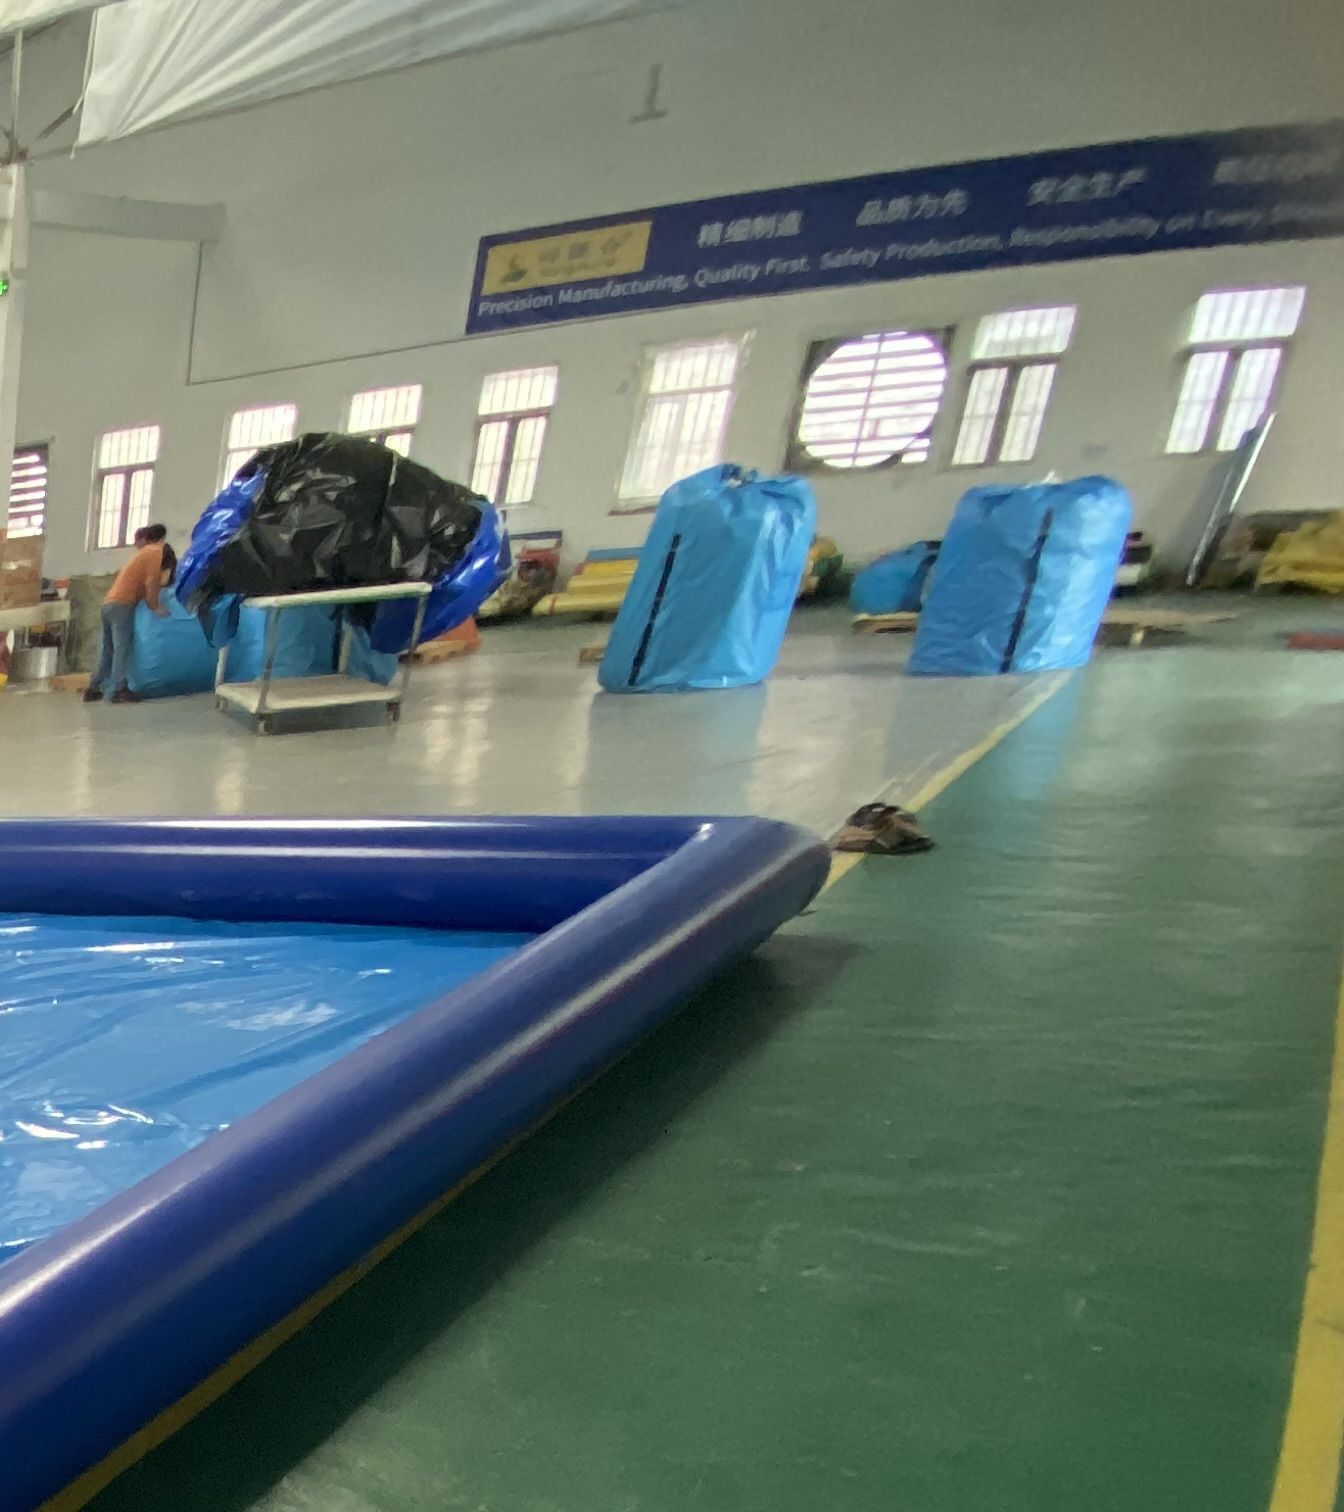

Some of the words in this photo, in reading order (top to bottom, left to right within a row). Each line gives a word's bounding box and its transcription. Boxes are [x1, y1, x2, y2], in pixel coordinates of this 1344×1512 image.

[477, 294, 553, 317] Precision
[694, 263, 760, 288] Quality
[819, 245, 881, 271] Safety
